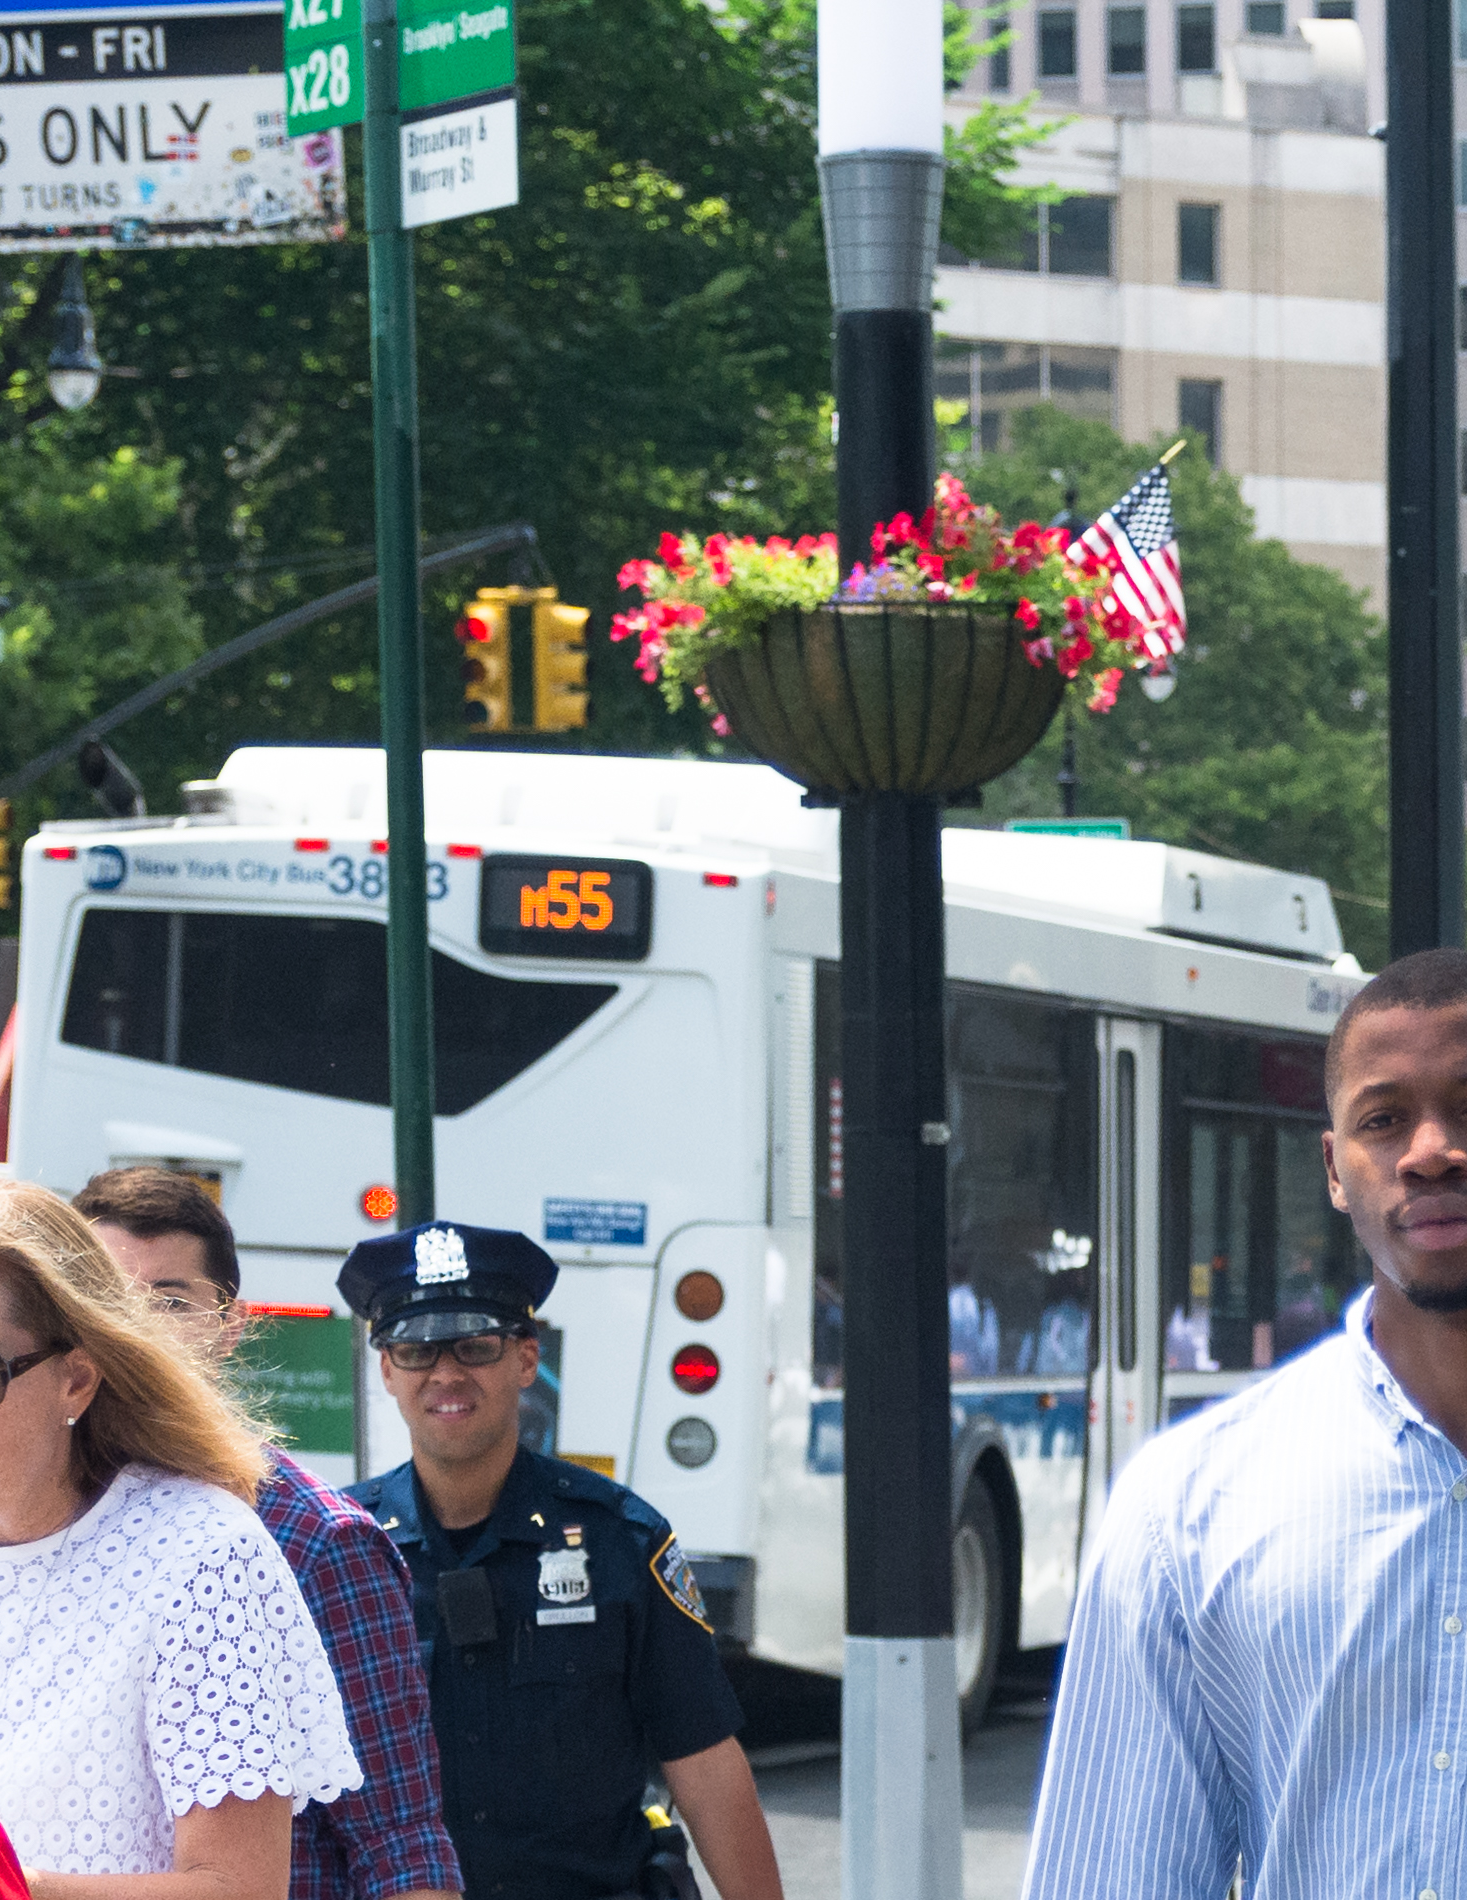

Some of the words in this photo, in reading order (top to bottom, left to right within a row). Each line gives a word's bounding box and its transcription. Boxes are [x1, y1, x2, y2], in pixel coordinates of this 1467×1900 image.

[92, 25, 167, 73] FRI
[42, 101, 211, 166] ONLY
[19, 181, 121, 213] TURNS
[329, 854, 447, 901] 383
